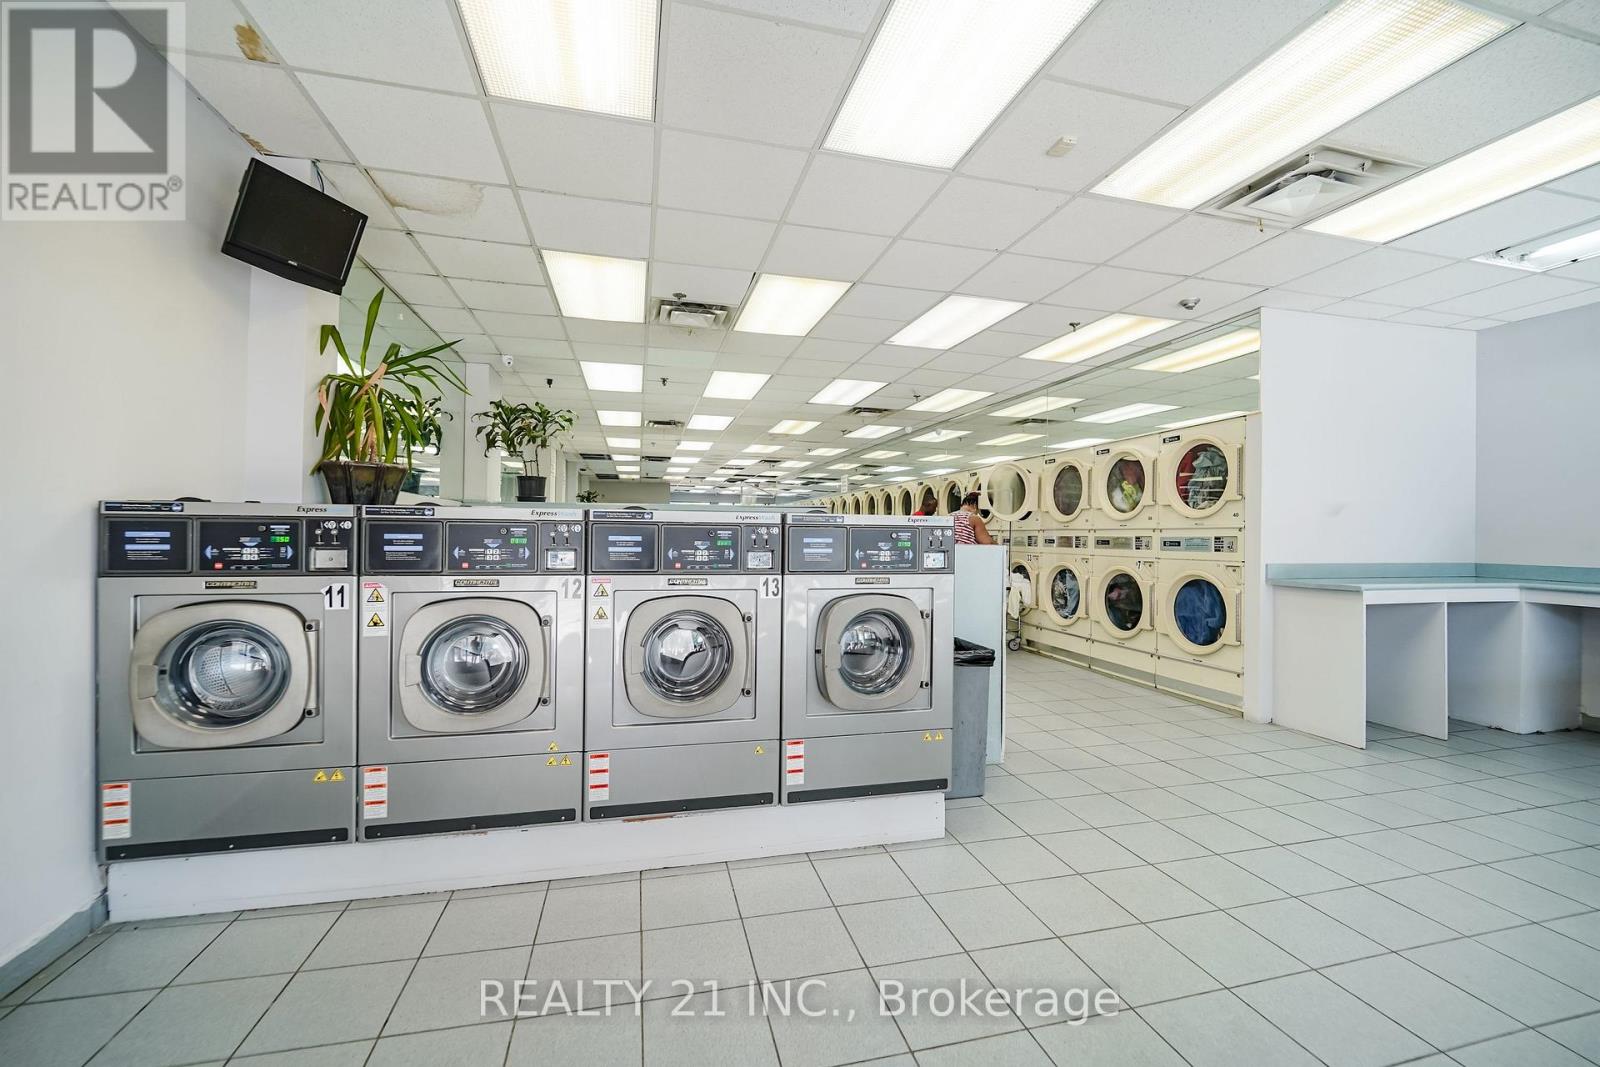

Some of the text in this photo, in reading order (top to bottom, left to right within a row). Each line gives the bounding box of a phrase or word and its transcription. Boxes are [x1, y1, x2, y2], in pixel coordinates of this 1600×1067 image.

[324, 585, 345, 608] 11
[561, 578, 582, 600] 12
[762, 577, 780, 597] 13
